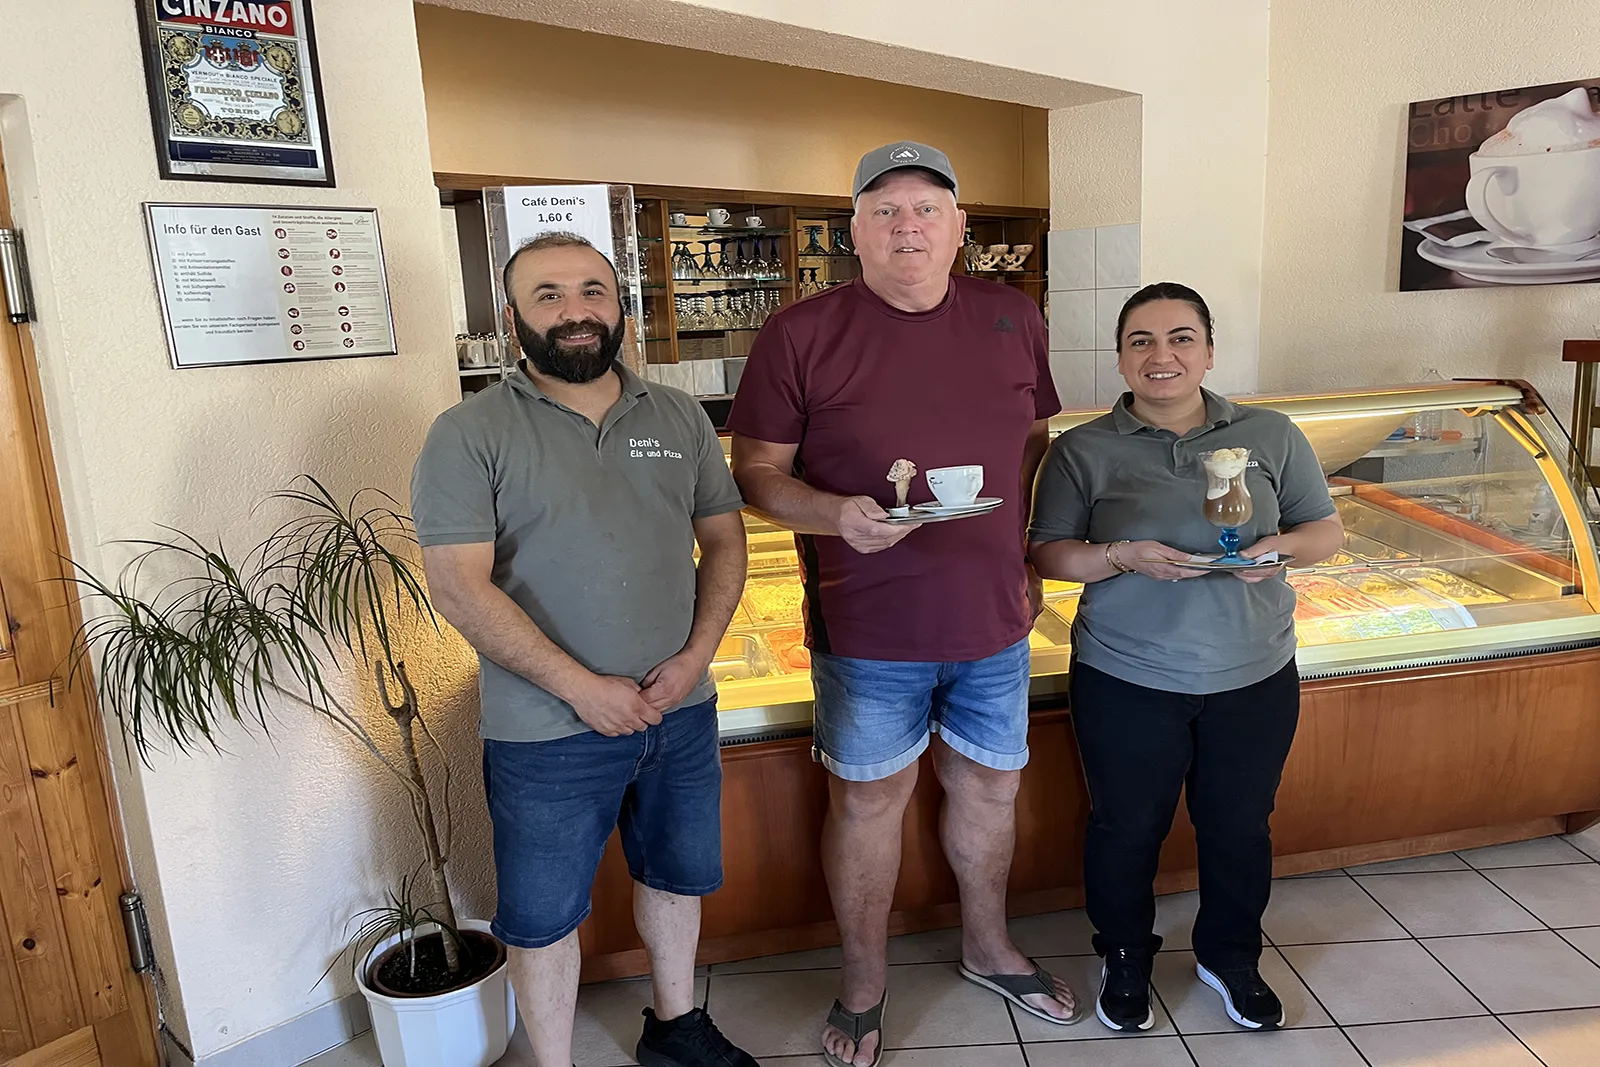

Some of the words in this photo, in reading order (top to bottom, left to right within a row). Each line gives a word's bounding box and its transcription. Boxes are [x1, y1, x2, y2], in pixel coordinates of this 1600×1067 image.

[161, 0, 287, 28] CINZANO
[205, 25, 252, 38] BIANCO
[191, 70, 225, 78] VERMOUTH
[225, 72, 249, 80] BIANCO
[250, 75, 278, 83] SPECIALE
[220, 107, 260, 115] TORINO
[521, 197, 548, 207] Café
[550, 197, 586, 206] Deni's
[537, 213, 562, 224] 1,60
[565, 212, 573, 222] €
[163, 224, 187, 234] Info
[190, 224, 207, 235] für
[211, 225, 232, 235] den
[235, 226, 262, 236] Gast
[629, 438, 660, 448] Deni's
[630, 449, 643, 458] Eis
[663, 450, 682, 459] Pizza
[1246, 460, 1259, 468] zza
